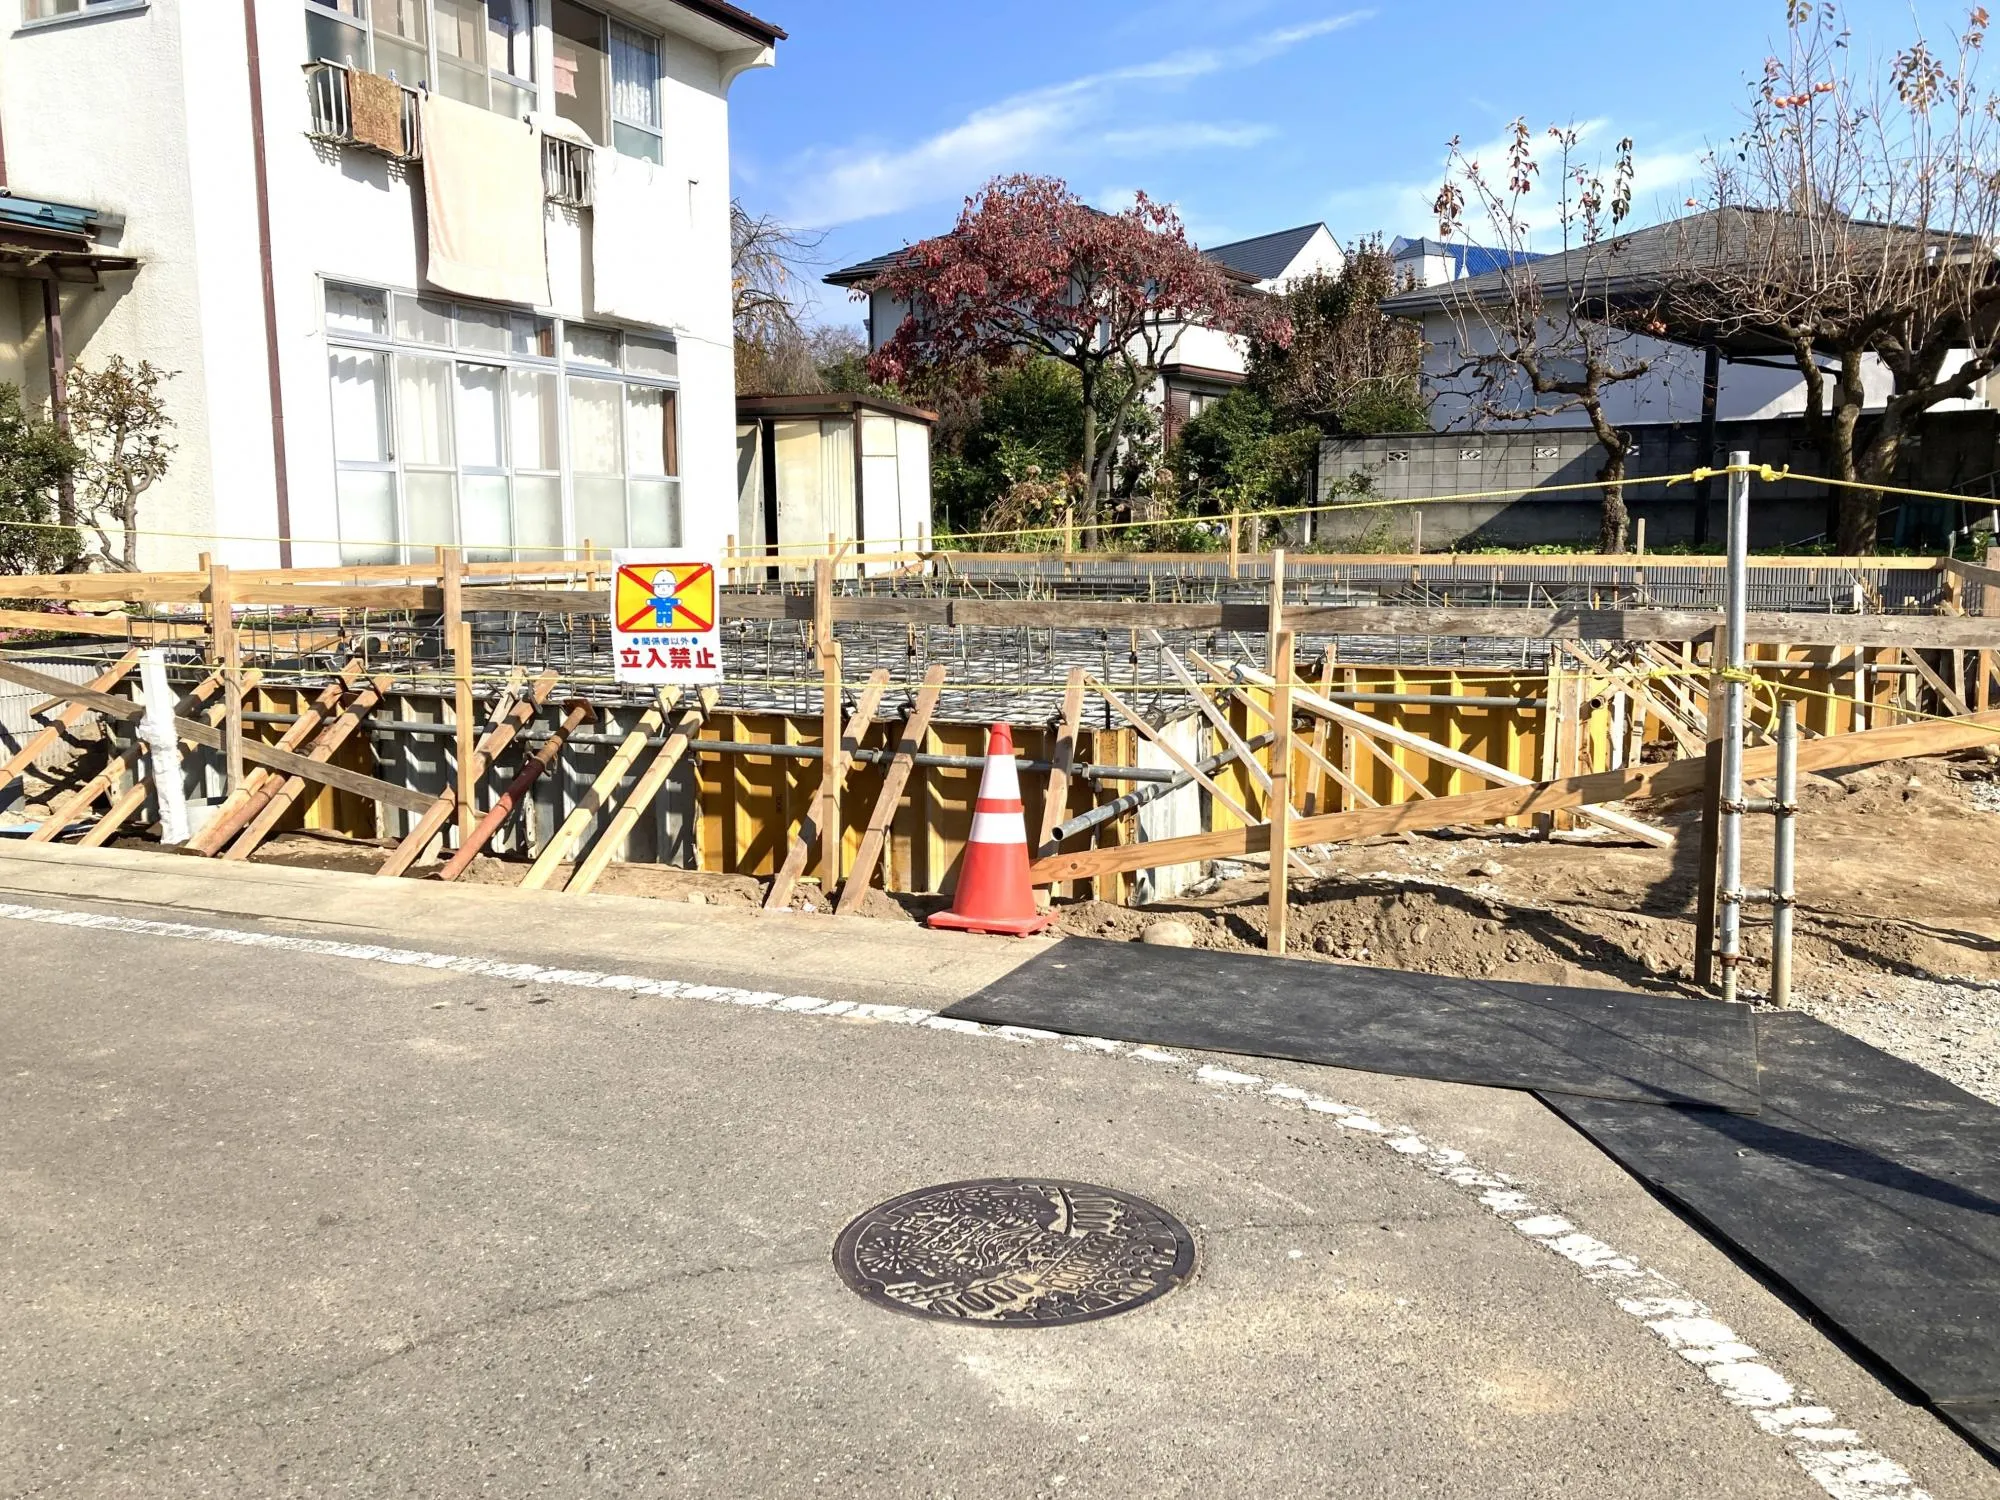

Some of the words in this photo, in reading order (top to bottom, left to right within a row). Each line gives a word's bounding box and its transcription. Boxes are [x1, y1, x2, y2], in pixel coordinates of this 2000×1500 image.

[641, 637, 689, 646] 関係者以外
[620, 647, 717, 669] 立入禁止
